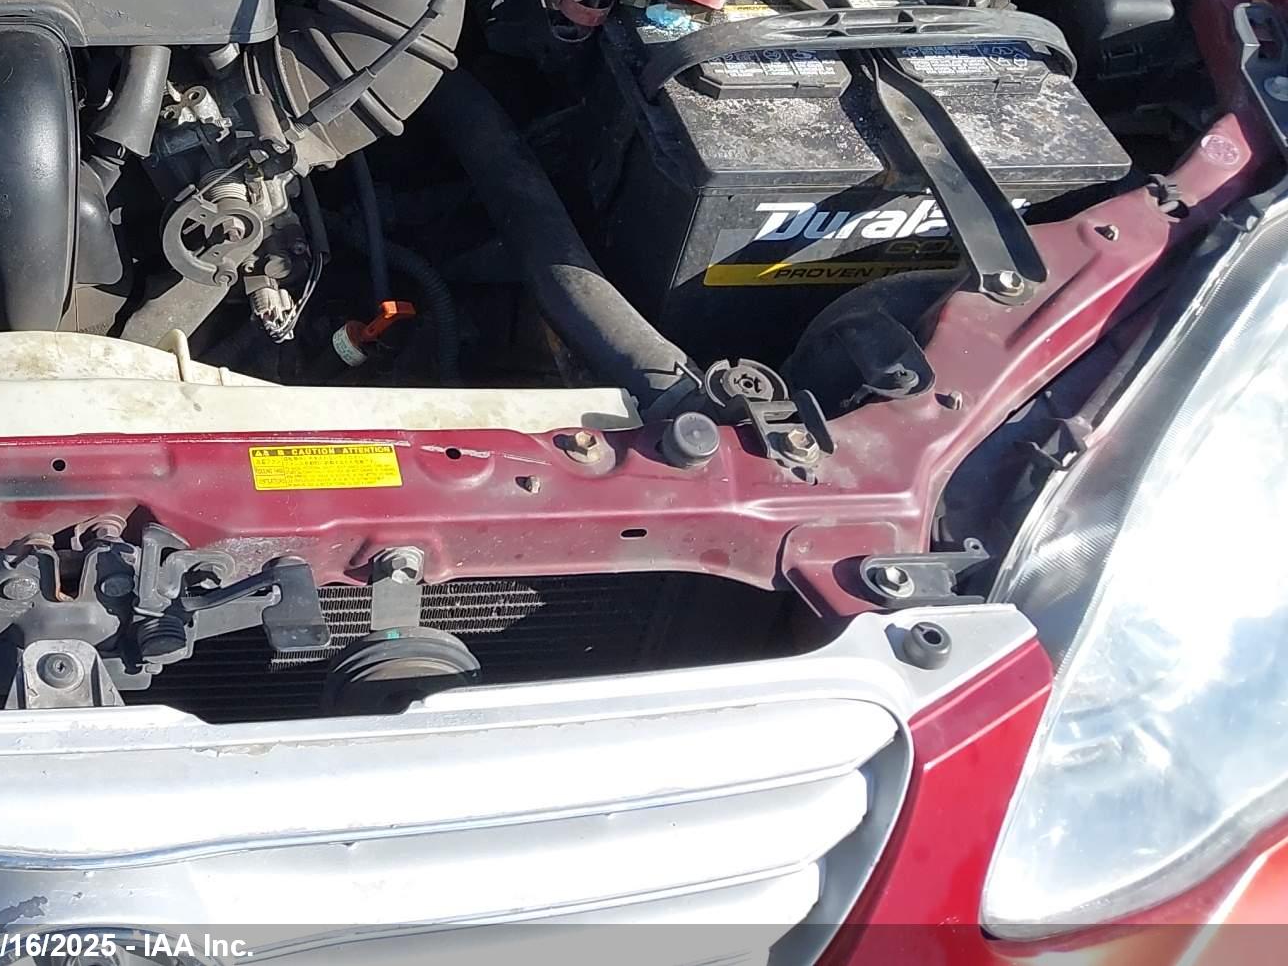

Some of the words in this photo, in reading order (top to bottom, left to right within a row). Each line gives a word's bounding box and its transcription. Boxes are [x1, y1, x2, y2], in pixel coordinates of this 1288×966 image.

[774, 266, 872, 281] PROVEN
[291, 446, 335, 455] CAUTION
[342, 445, 391, 455] ATTENTION
